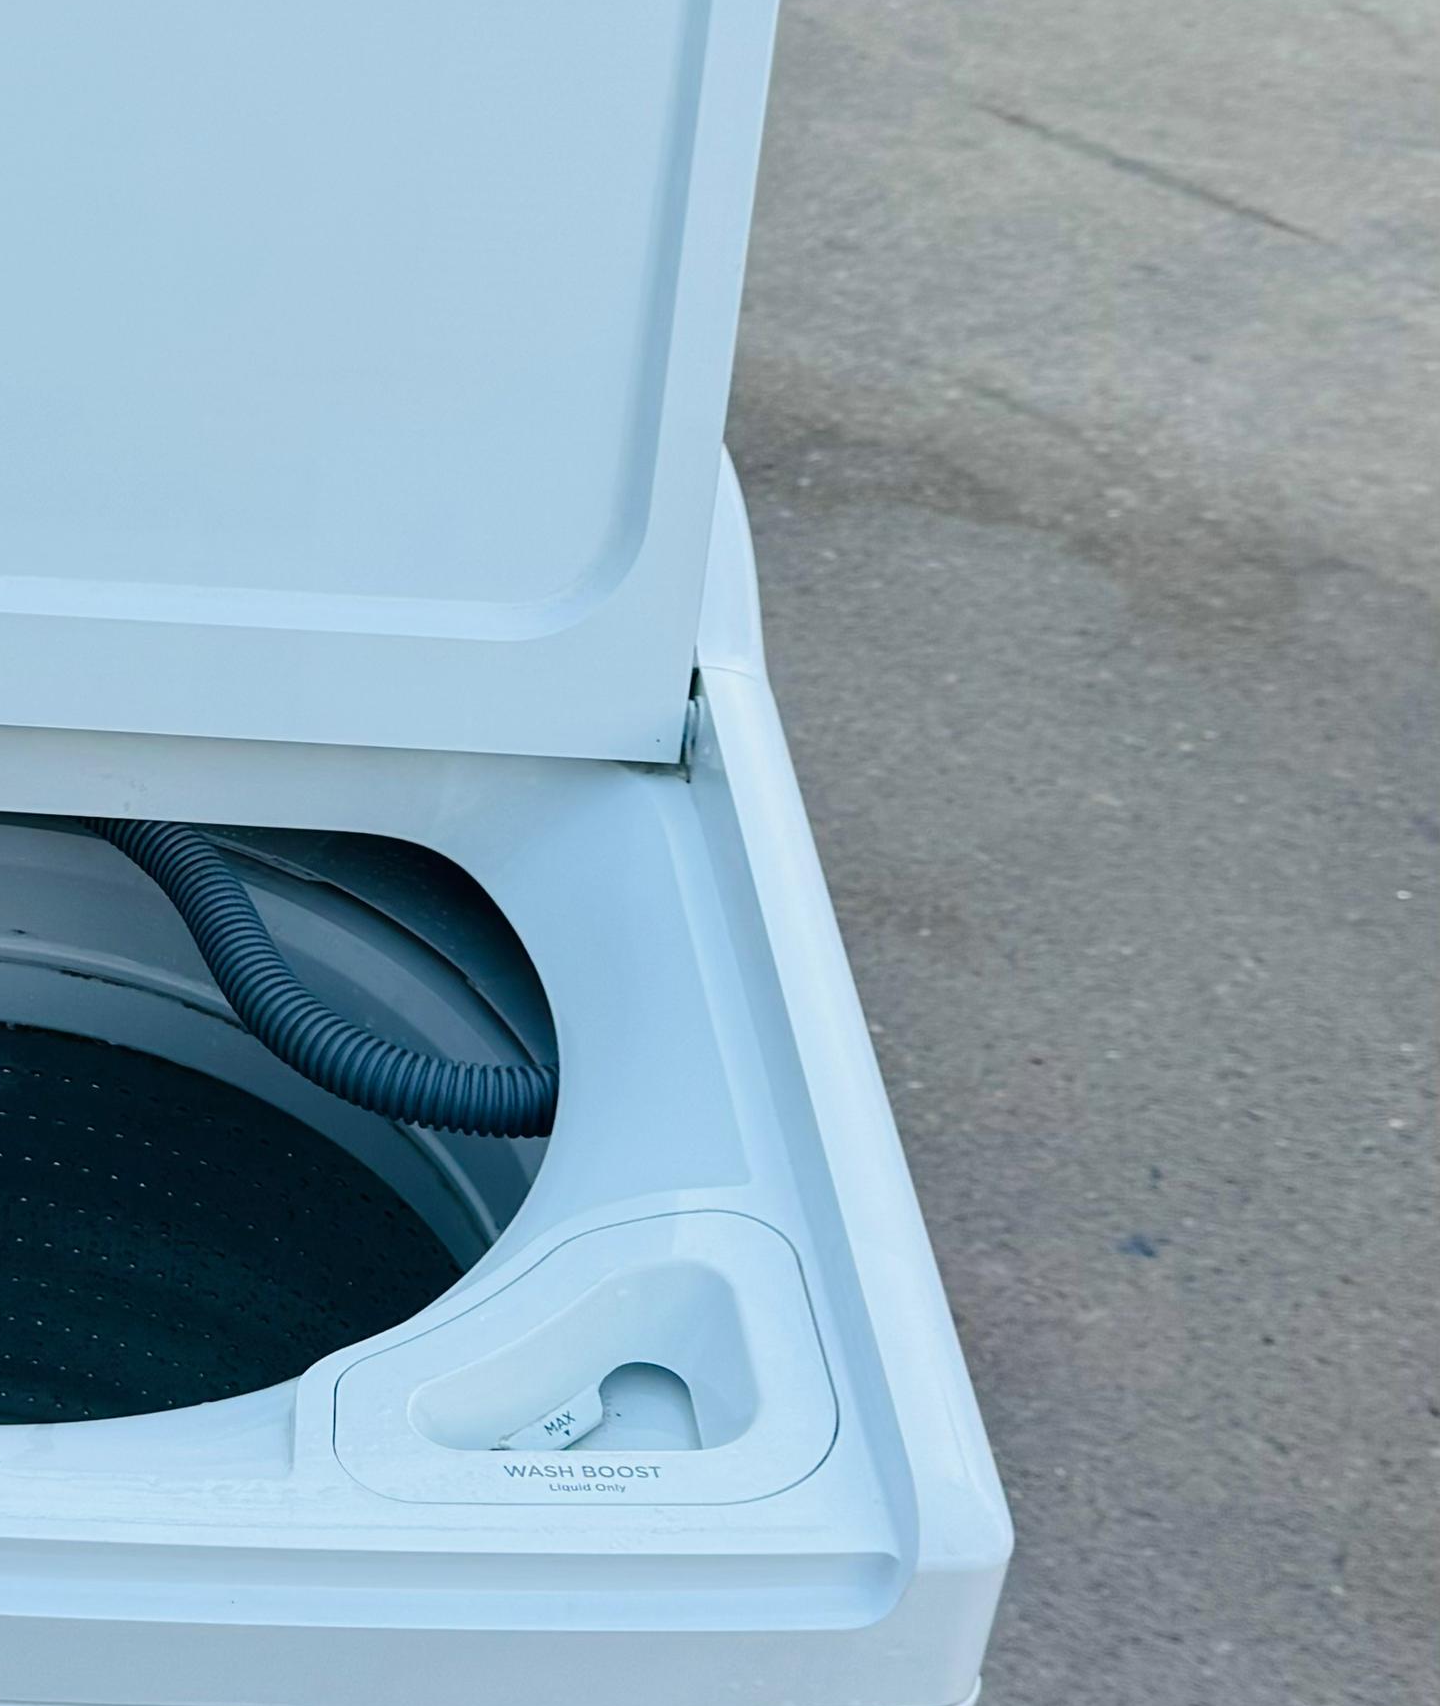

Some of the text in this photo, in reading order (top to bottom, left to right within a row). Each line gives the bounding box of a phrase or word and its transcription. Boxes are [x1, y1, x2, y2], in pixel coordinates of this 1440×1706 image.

[543, 1410, 576, 1436] MAX
[503, 1465, 662, 1479] WASH BOOST
[549, 1483, 626, 1493] Liquid Only
